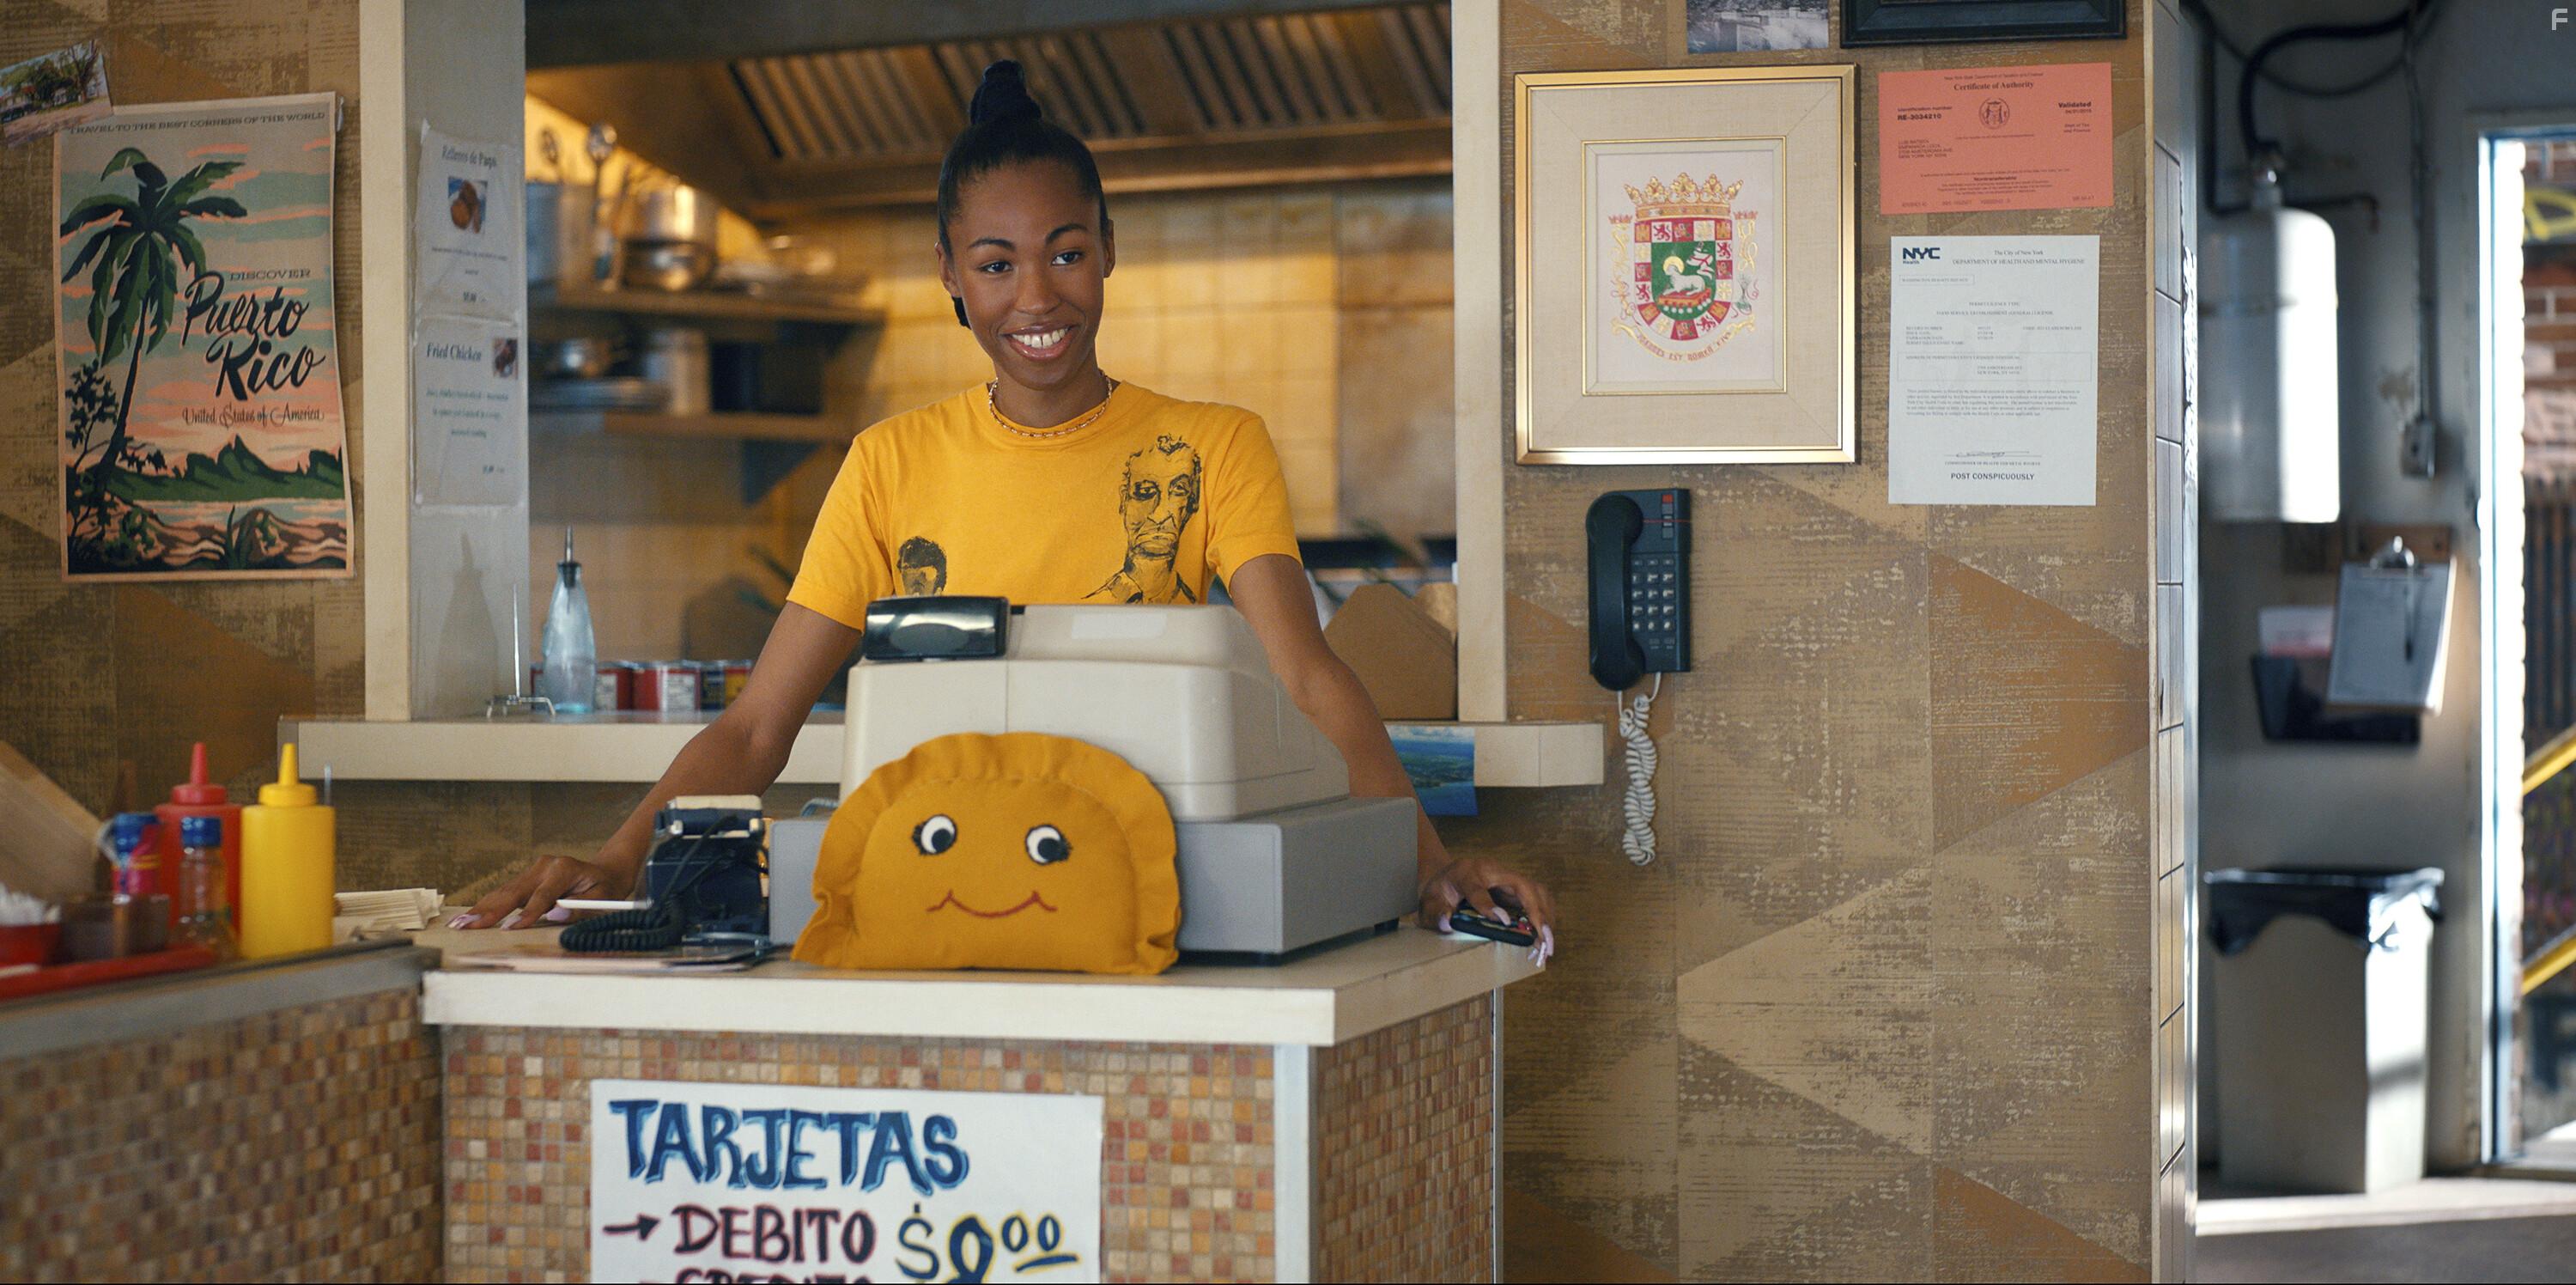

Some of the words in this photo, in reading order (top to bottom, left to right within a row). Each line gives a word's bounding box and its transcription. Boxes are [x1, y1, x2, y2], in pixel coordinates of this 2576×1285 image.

[1953, 82, 1990, 91] Certificate
[2002, 81, 2034, 89] Authority
[69, 124, 112, 135] TRAVEL
[115, 123, 131, 131] TO
[131, 122, 156, 131] THE
[158, 120, 188, 130] BEST
[190, 117, 242, 128] CORNERS
[244, 116, 258, 125] OF
[260, 114, 284, 124] THE
[286, 112, 325, 122] WORLD
[1902, 247, 1941, 259] NYC
[229, 268, 311, 282] DISCOVER
[181, 271, 310, 347] Puerto
[427, 342, 449, 360] Fried
[450, 344, 482, 361] Chicken
[205, 326, 326, 402] Rico
[182, 406, 216, 427] United
[219, 401, 255, 429] States
[257, 405, 269, 428] of
[270, 401, 325, 428] America
[1971, 472, 2035, 481] CONSPICUOUSLY
[608, 1099, 970, 1196] TARJETAS
[670, 1203, 878, 1264] DEBITO
